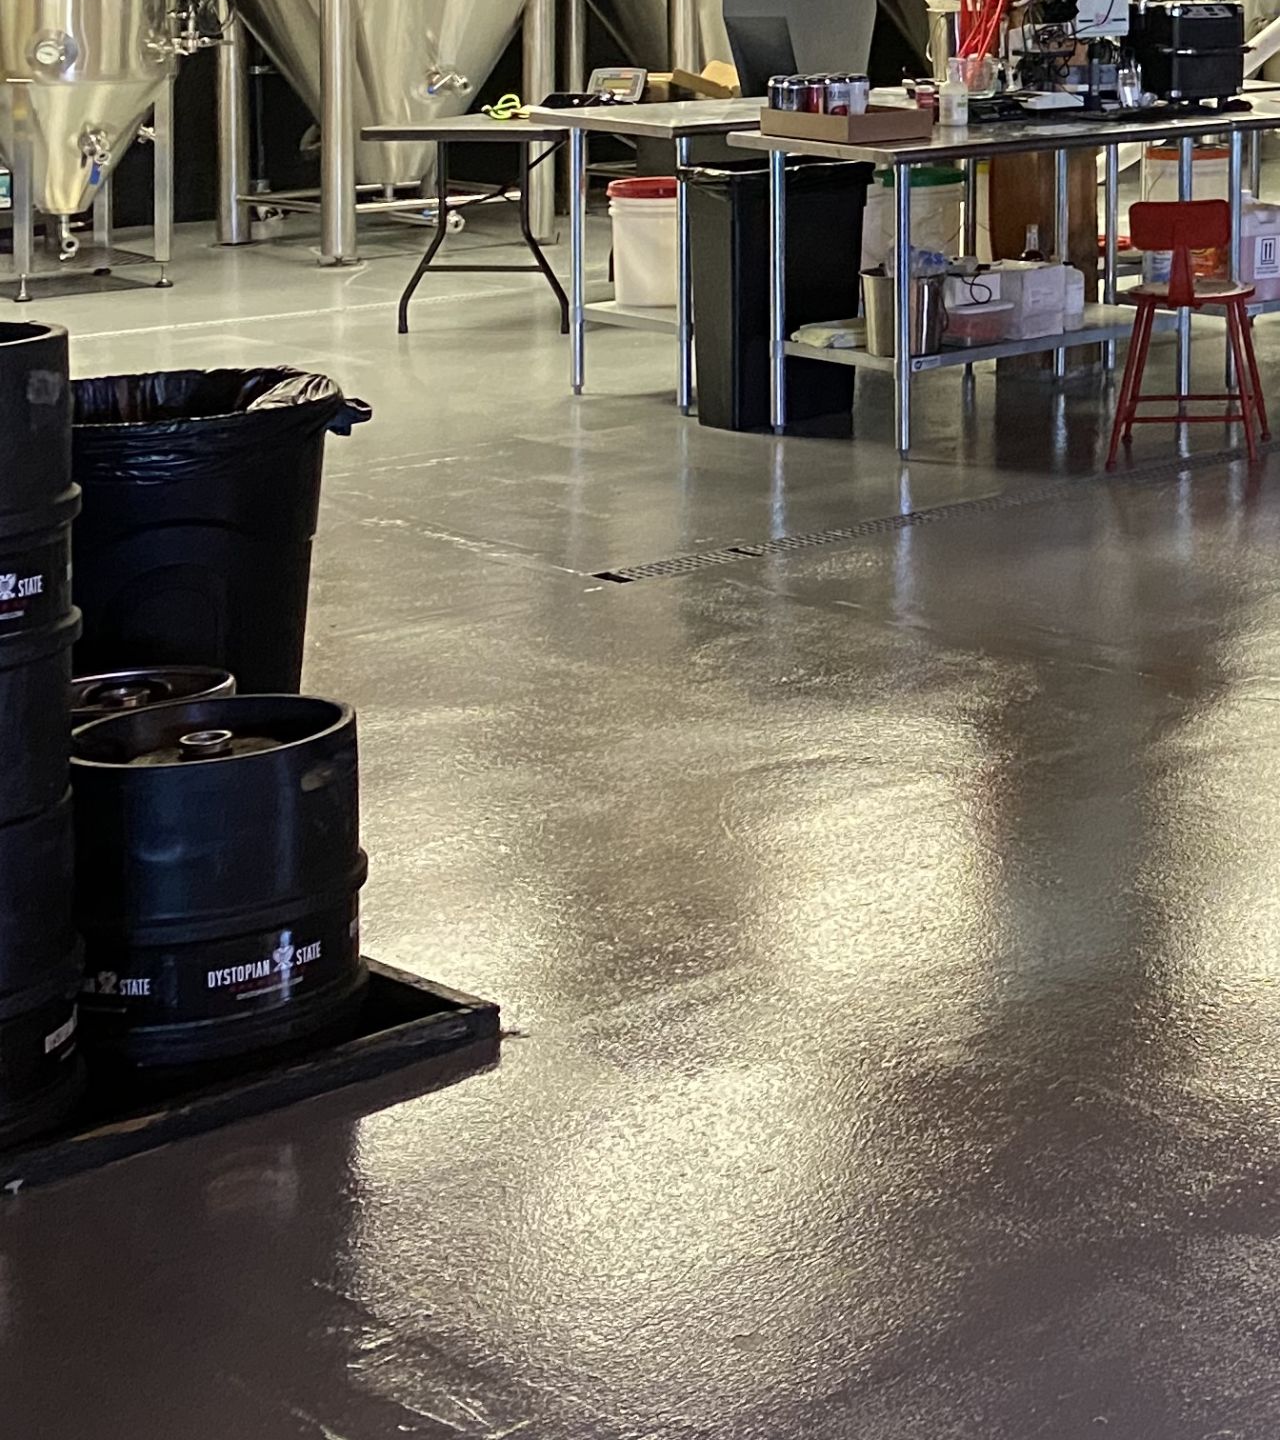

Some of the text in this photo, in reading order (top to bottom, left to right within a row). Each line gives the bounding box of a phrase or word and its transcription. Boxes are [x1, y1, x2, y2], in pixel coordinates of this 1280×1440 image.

[18, 574, 43, 597] STATE
[207, 959, 271, 988] DYSTOPIAN
[296, 940, 322, 966] STATE
[119, 978, 151, 996] STATE
